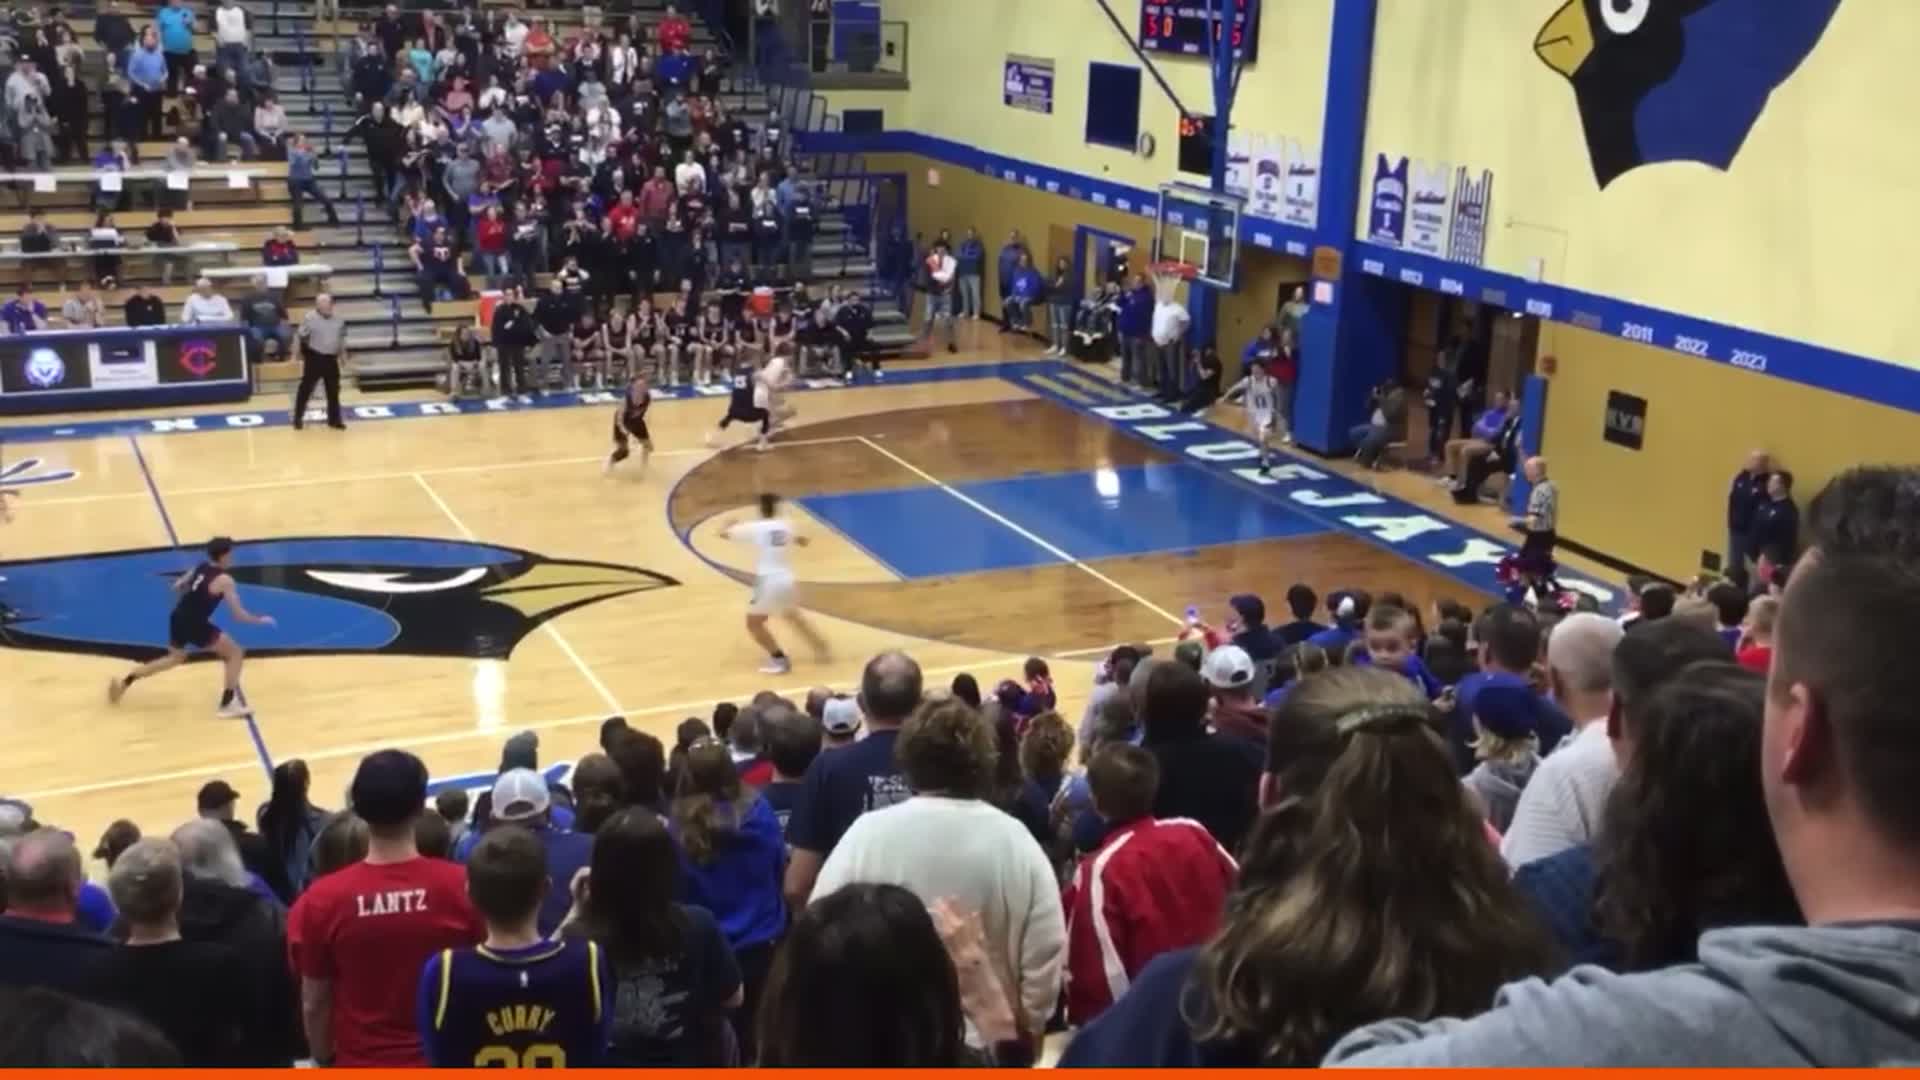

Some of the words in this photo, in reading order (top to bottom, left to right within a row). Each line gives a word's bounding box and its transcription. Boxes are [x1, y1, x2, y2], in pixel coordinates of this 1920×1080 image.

[1674, 334, 1709, 356] 2022
[1730, 348, 1767, 371] 2023
[357, 889, 428, 917] LANTZ
[485, 1004, 556, 1036] CURRY
